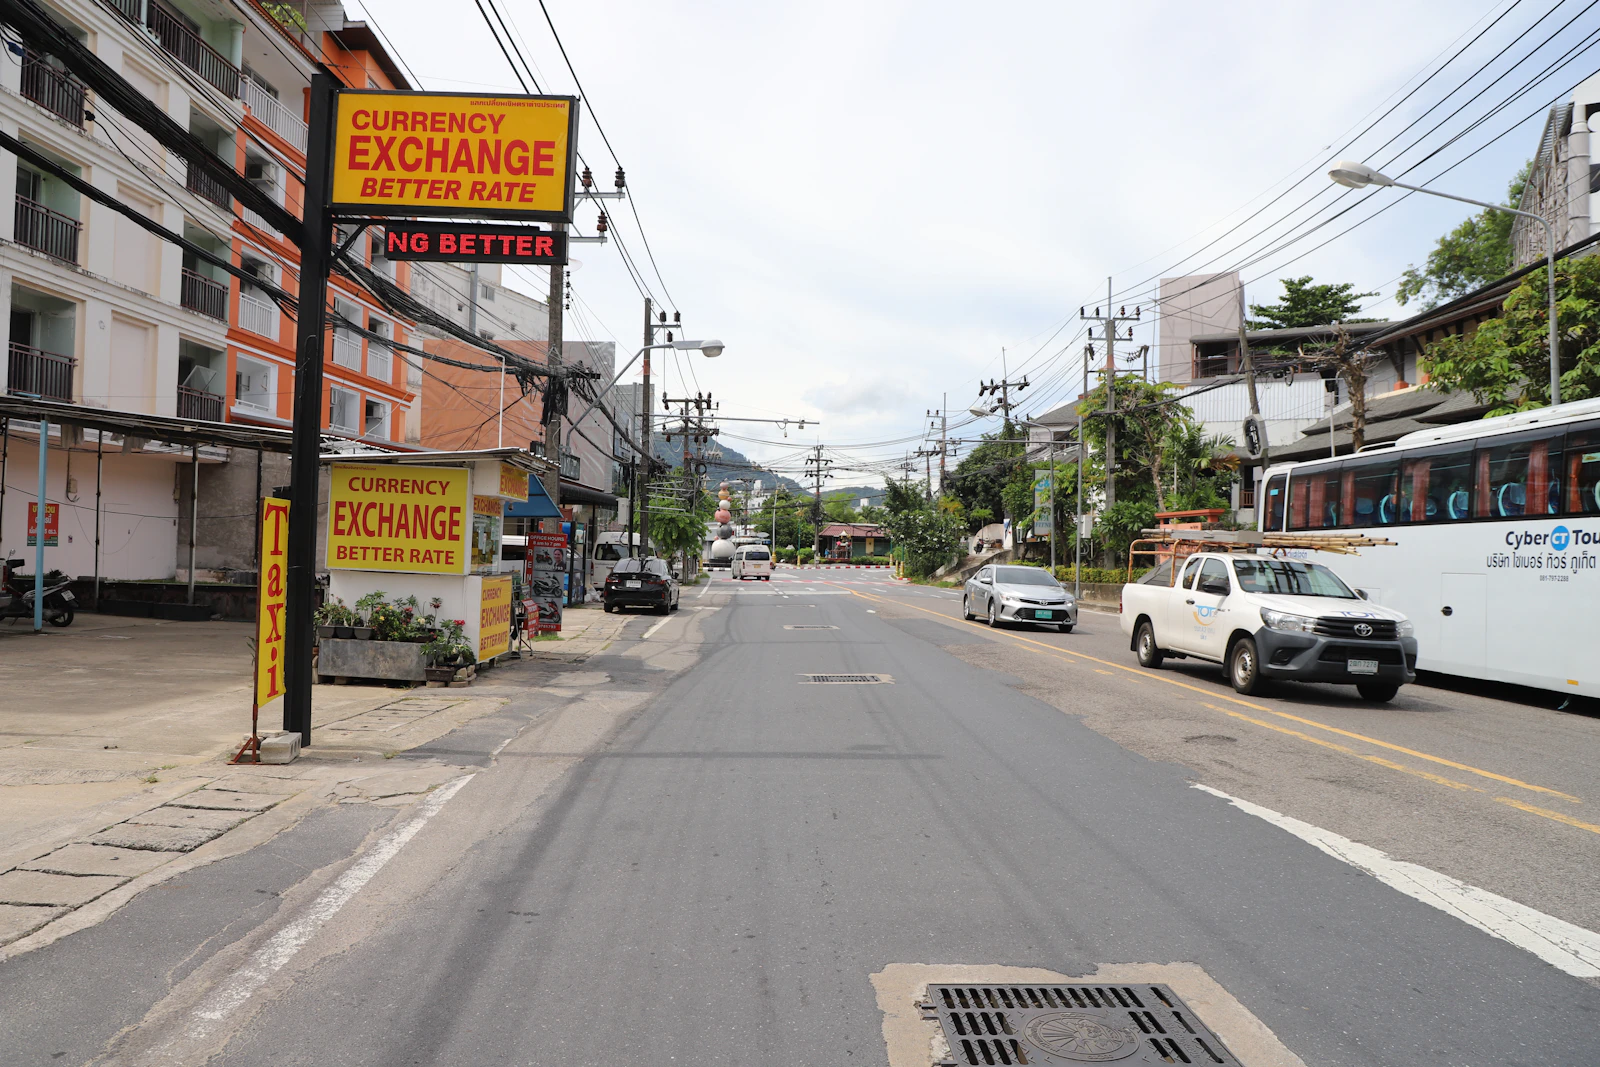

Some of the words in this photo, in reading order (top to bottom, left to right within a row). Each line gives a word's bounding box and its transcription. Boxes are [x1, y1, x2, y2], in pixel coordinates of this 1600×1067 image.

[351, 109, 506, 134] CURRENCY
[348, 135, 556, 177] EXCHANGE
[360, 177, 462, 200] BETTER
[468, 181, 537, 203] RATE
[388, 231, 429, 253] NG
[439, 233, 555, 257] BETTER
[348, 476, 451, 496] CURRENCY
[474, 497, 501, 514] EXCHANGE
[333, 500, 462, 542] EXCHANGE
[1505, 530, 1550, 550] Cyber
[336, 545, 405, 562] BETTER
[409, 548, 455, 565] RATE
[1486, 552, 1510, 568] บริษัท
[1512, 551, 1543, 569] ไซเบอร์
[1546, 551, 1567, 569] ทัวร์
[1570, 550, 1597, 574] ภูเก็ต
[264, 503, 288, 698] Taxi
[482, 587, 502, 601] CURRENCY
[481, 603, 511, 629] EXCHANGE
[480, 633, 498, 651] BETTER
[498, 630, 508, 645] RATE
